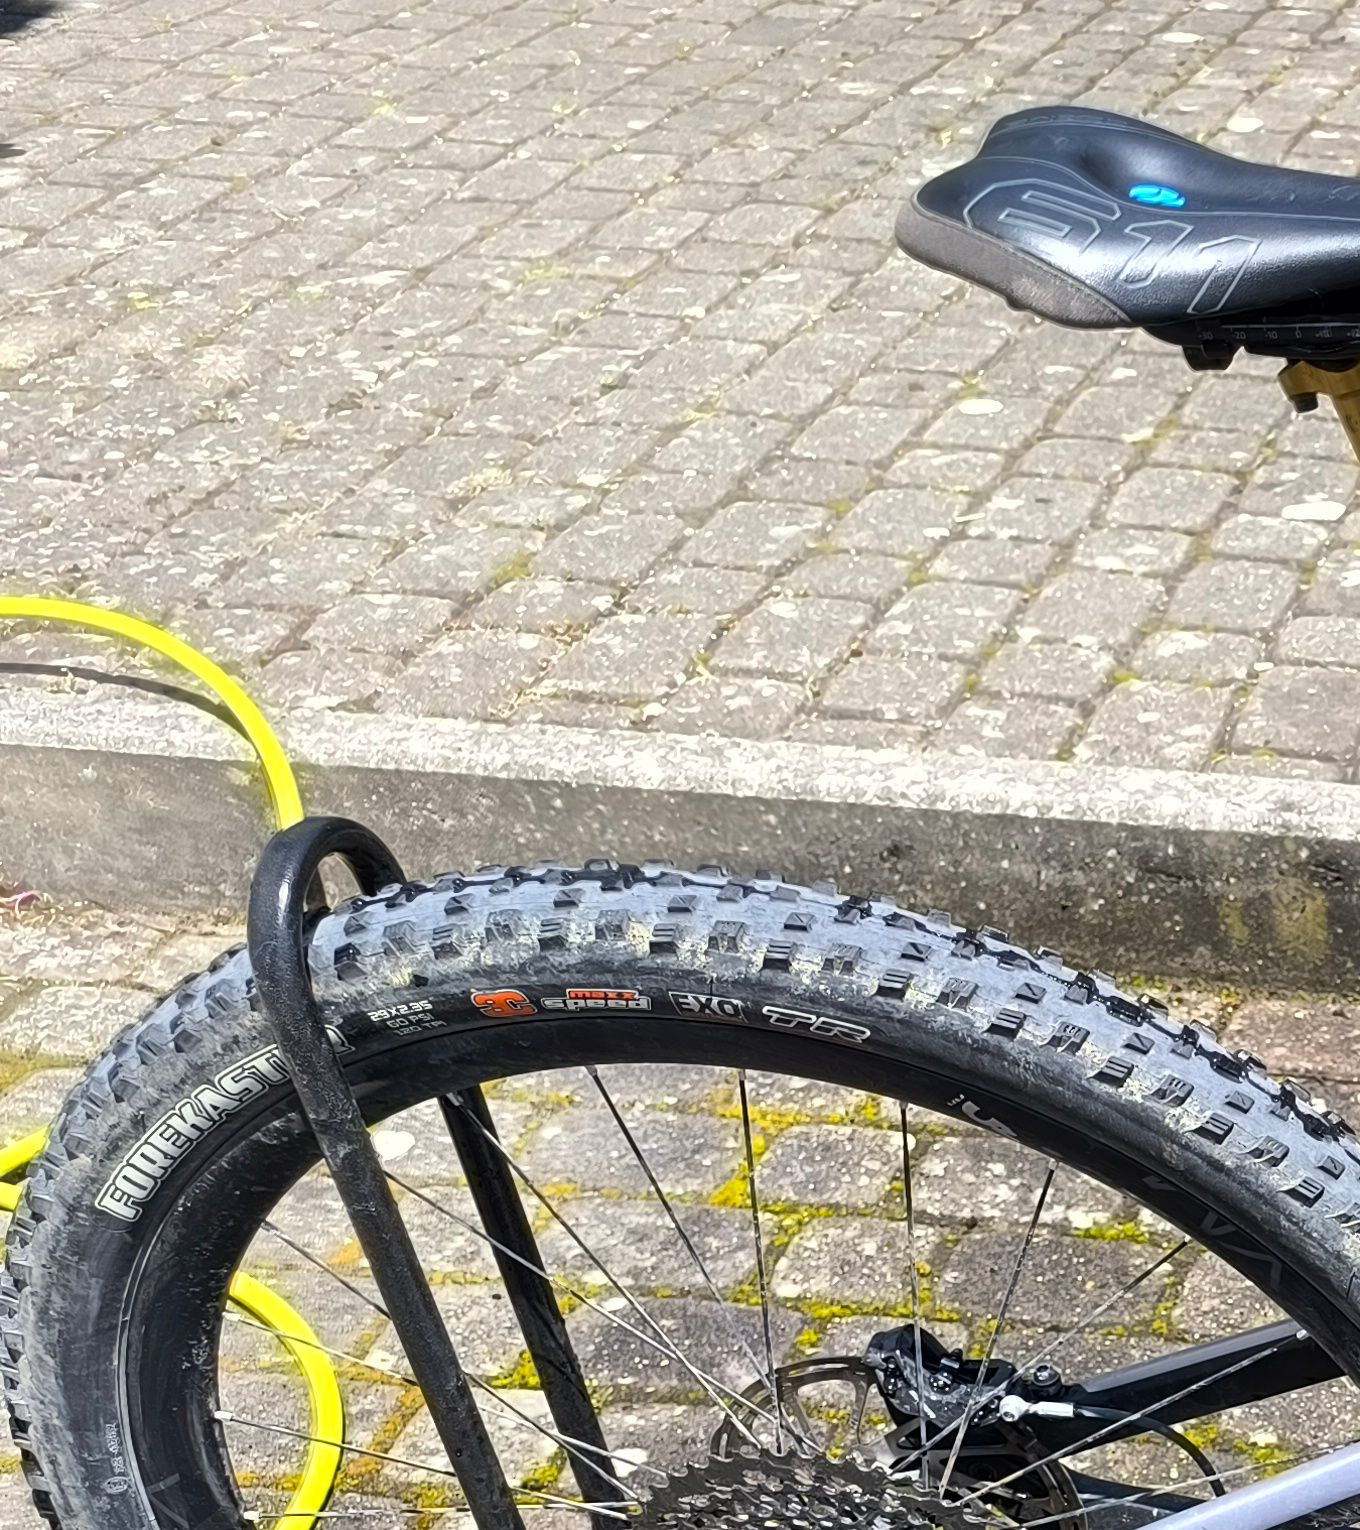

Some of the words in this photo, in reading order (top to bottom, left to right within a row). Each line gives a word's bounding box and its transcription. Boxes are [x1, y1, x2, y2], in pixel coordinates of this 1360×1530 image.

[410, 1012, 434, 1024] PSI
[761, 1005, 872, 1044] TR
[95, 1024, 356, 1222] FOREKAST
